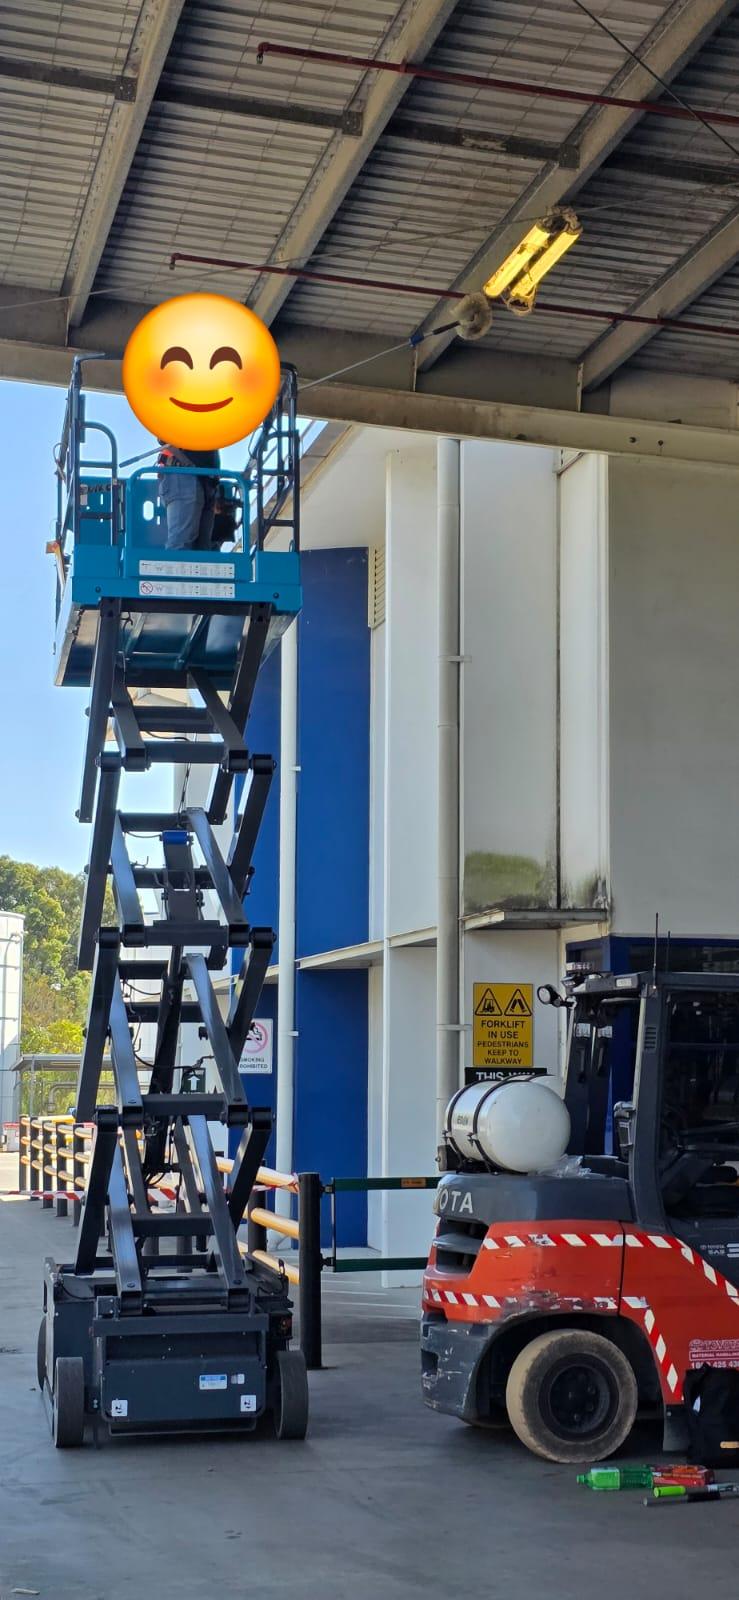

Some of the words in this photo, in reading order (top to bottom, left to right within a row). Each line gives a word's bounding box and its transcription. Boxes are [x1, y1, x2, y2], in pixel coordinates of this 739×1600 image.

[481, 1020, 526, 1029] FORKLIFT
[488, 1030, 498, 1039] IN
[500, 1030, 519, 1039] USE
[477, 1040, 529, 1048] PEDESTRIANS
[509, 1049, 519, 1057] TO
[484, 1057, 522, 1065] WALKWAY
[475, 1071, 504, 1081] THIS
